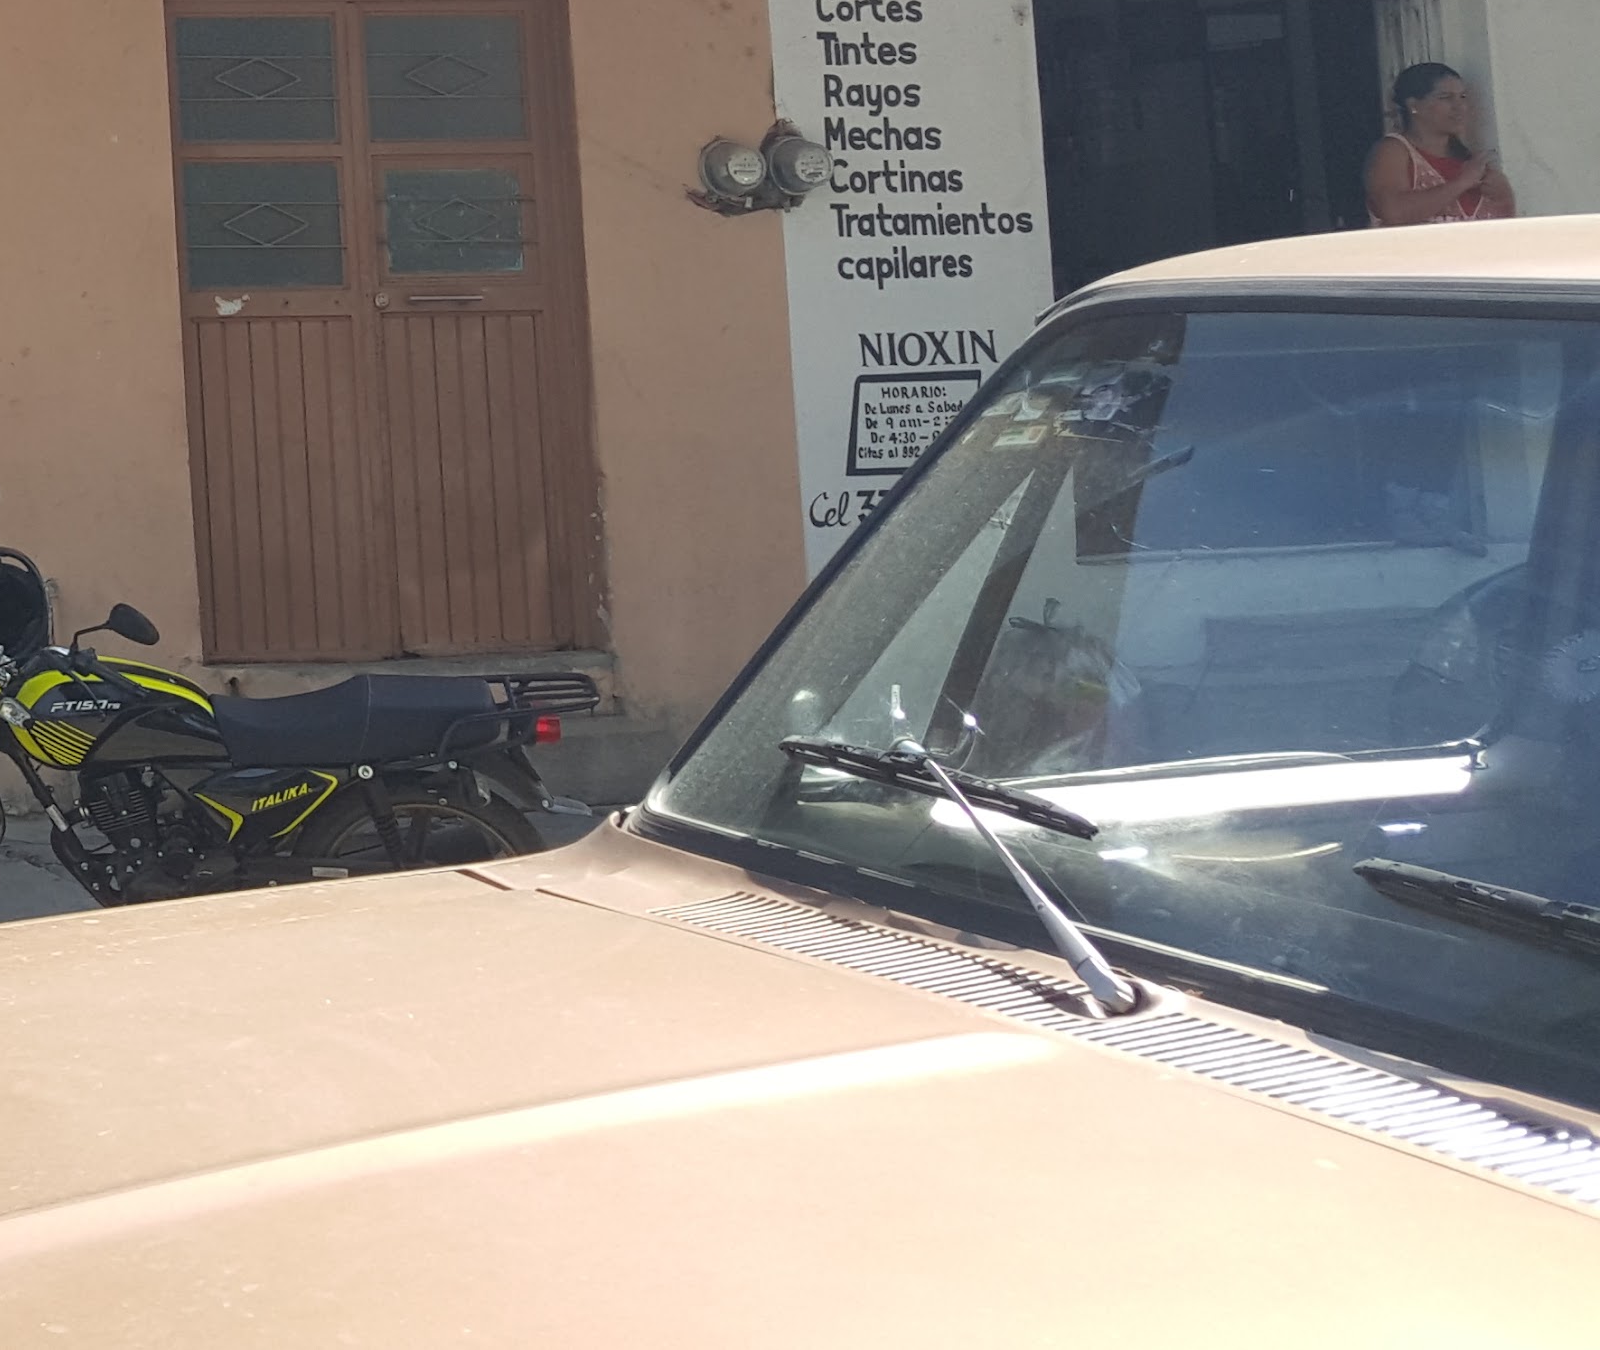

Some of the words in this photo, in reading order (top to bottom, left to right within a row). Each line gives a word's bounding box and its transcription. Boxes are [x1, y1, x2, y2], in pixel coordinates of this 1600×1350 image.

[816, 31, 917, 66] Tintes
[823, 74, 921, 116] Rayos
[824, 116, 942, 151] Mechas
[829, 159, 963, 194] Cortinas
[829, 202, 1033, 238] Tratamientos
[837, 246, 973, 290] capilares
[858, 329, 999, 367] NIOXIN
[864, 402, 877, 415] De
[879, 402, 911, 415] Lunes
[915, 405, 924, 413] a
[928, 400, 963, 413] Sabad
[881, 386, 947, 399] HORARIO:
[865, 417, 879, 429] De
[886, 417, 894, 429] 9
[888, 431, 917, 444] 4:30
[888, 447, 899, 458] al
[809, 491, 852, 528] Cel
[251, 782, 308, 812] ITALIKA
